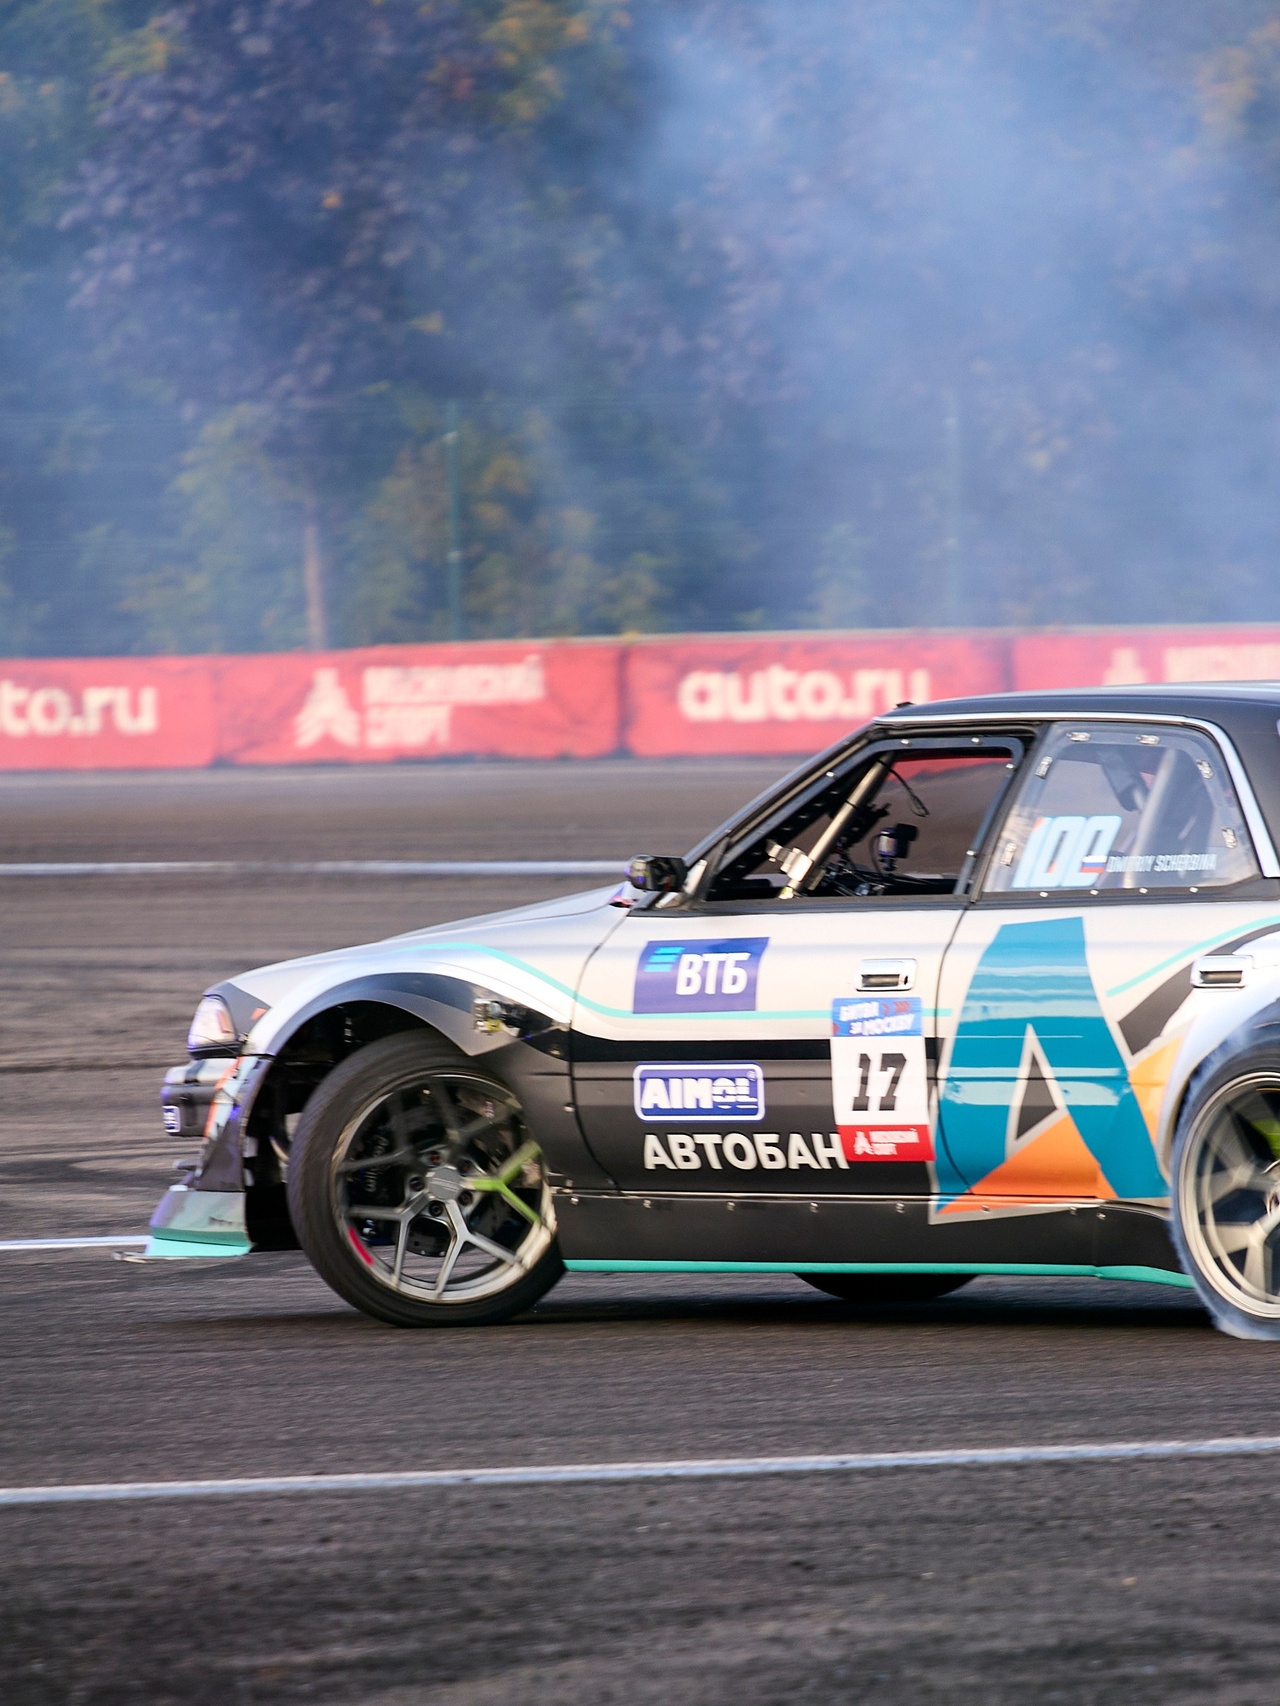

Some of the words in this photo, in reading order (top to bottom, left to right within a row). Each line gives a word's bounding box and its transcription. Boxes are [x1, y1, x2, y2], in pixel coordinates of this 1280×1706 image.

[679, 664, 931, 722] auto.ru
[675, 952, 751, 995] ВТБ
[852, 1052, 907, 1112] 17
[643, 1133, 850, 1170] АВТОБАН
